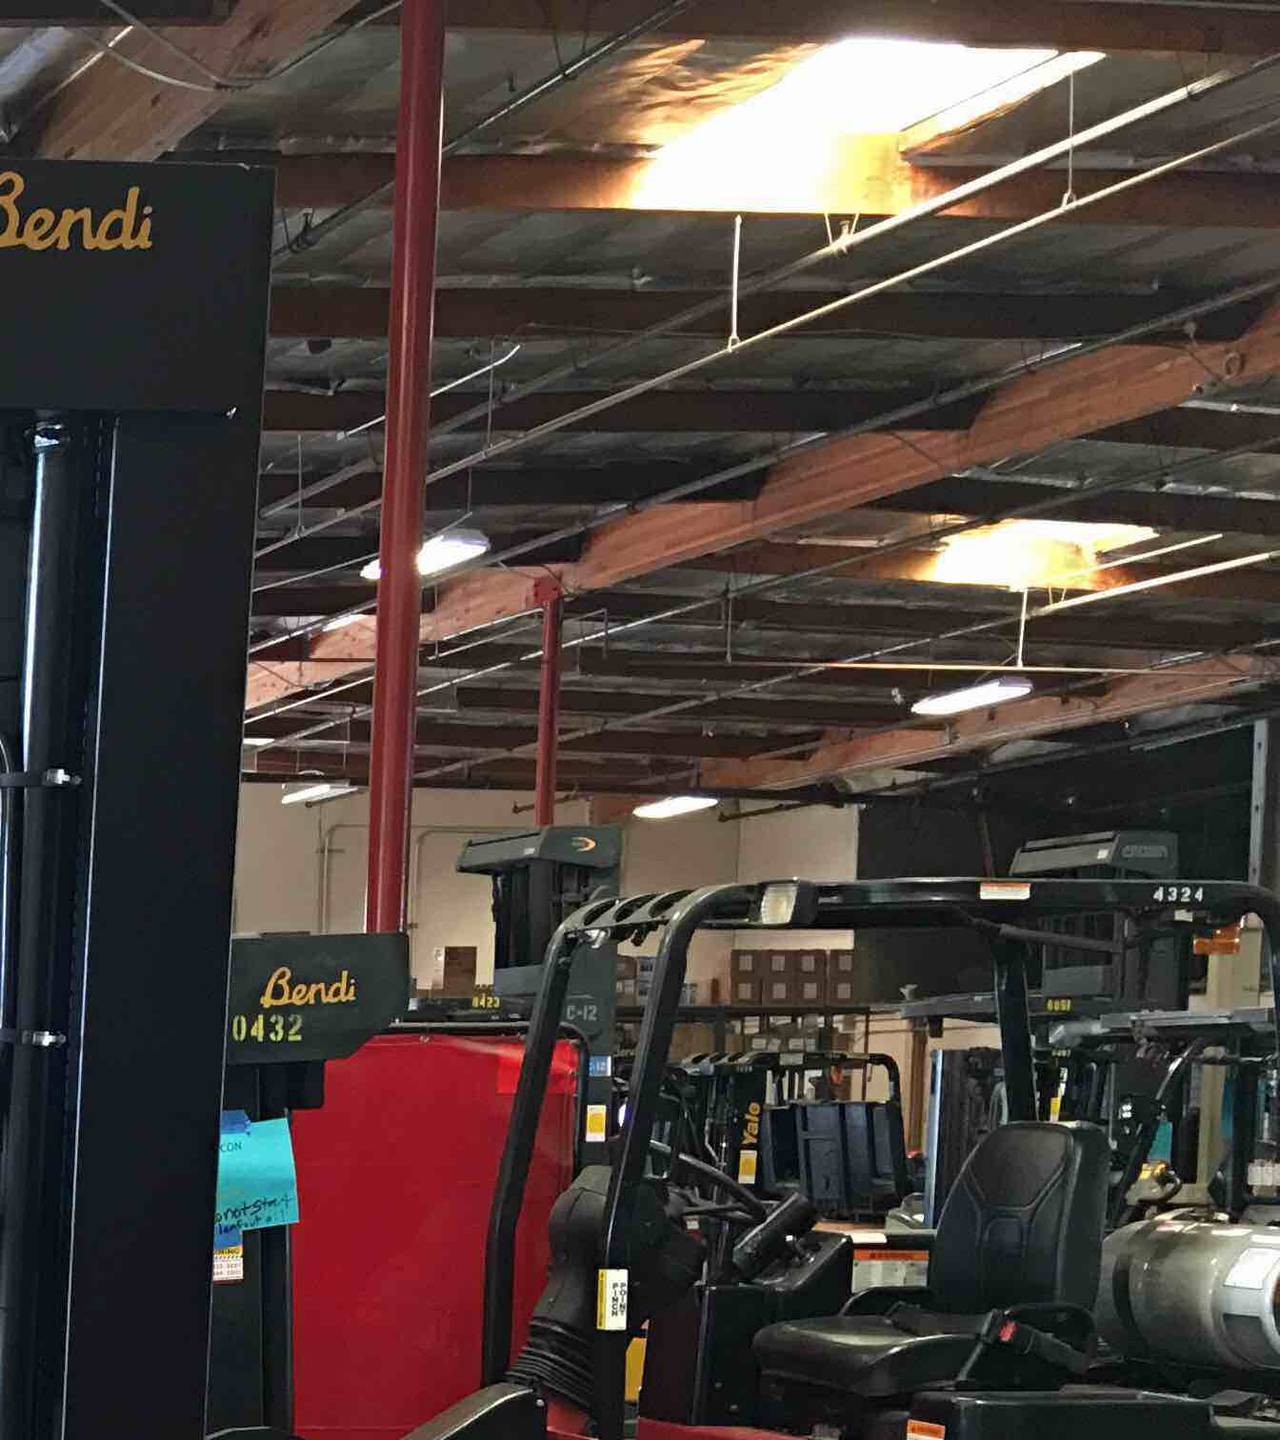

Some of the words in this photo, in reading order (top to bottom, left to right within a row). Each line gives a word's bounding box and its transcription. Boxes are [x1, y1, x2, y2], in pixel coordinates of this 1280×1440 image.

[1153, 886, 1204, 902] 4324
[260, 966, 357, 1008] Bendi
[566, 1004, 598, 1021] C-12
[232, 1014, 303, 1042] 0432
